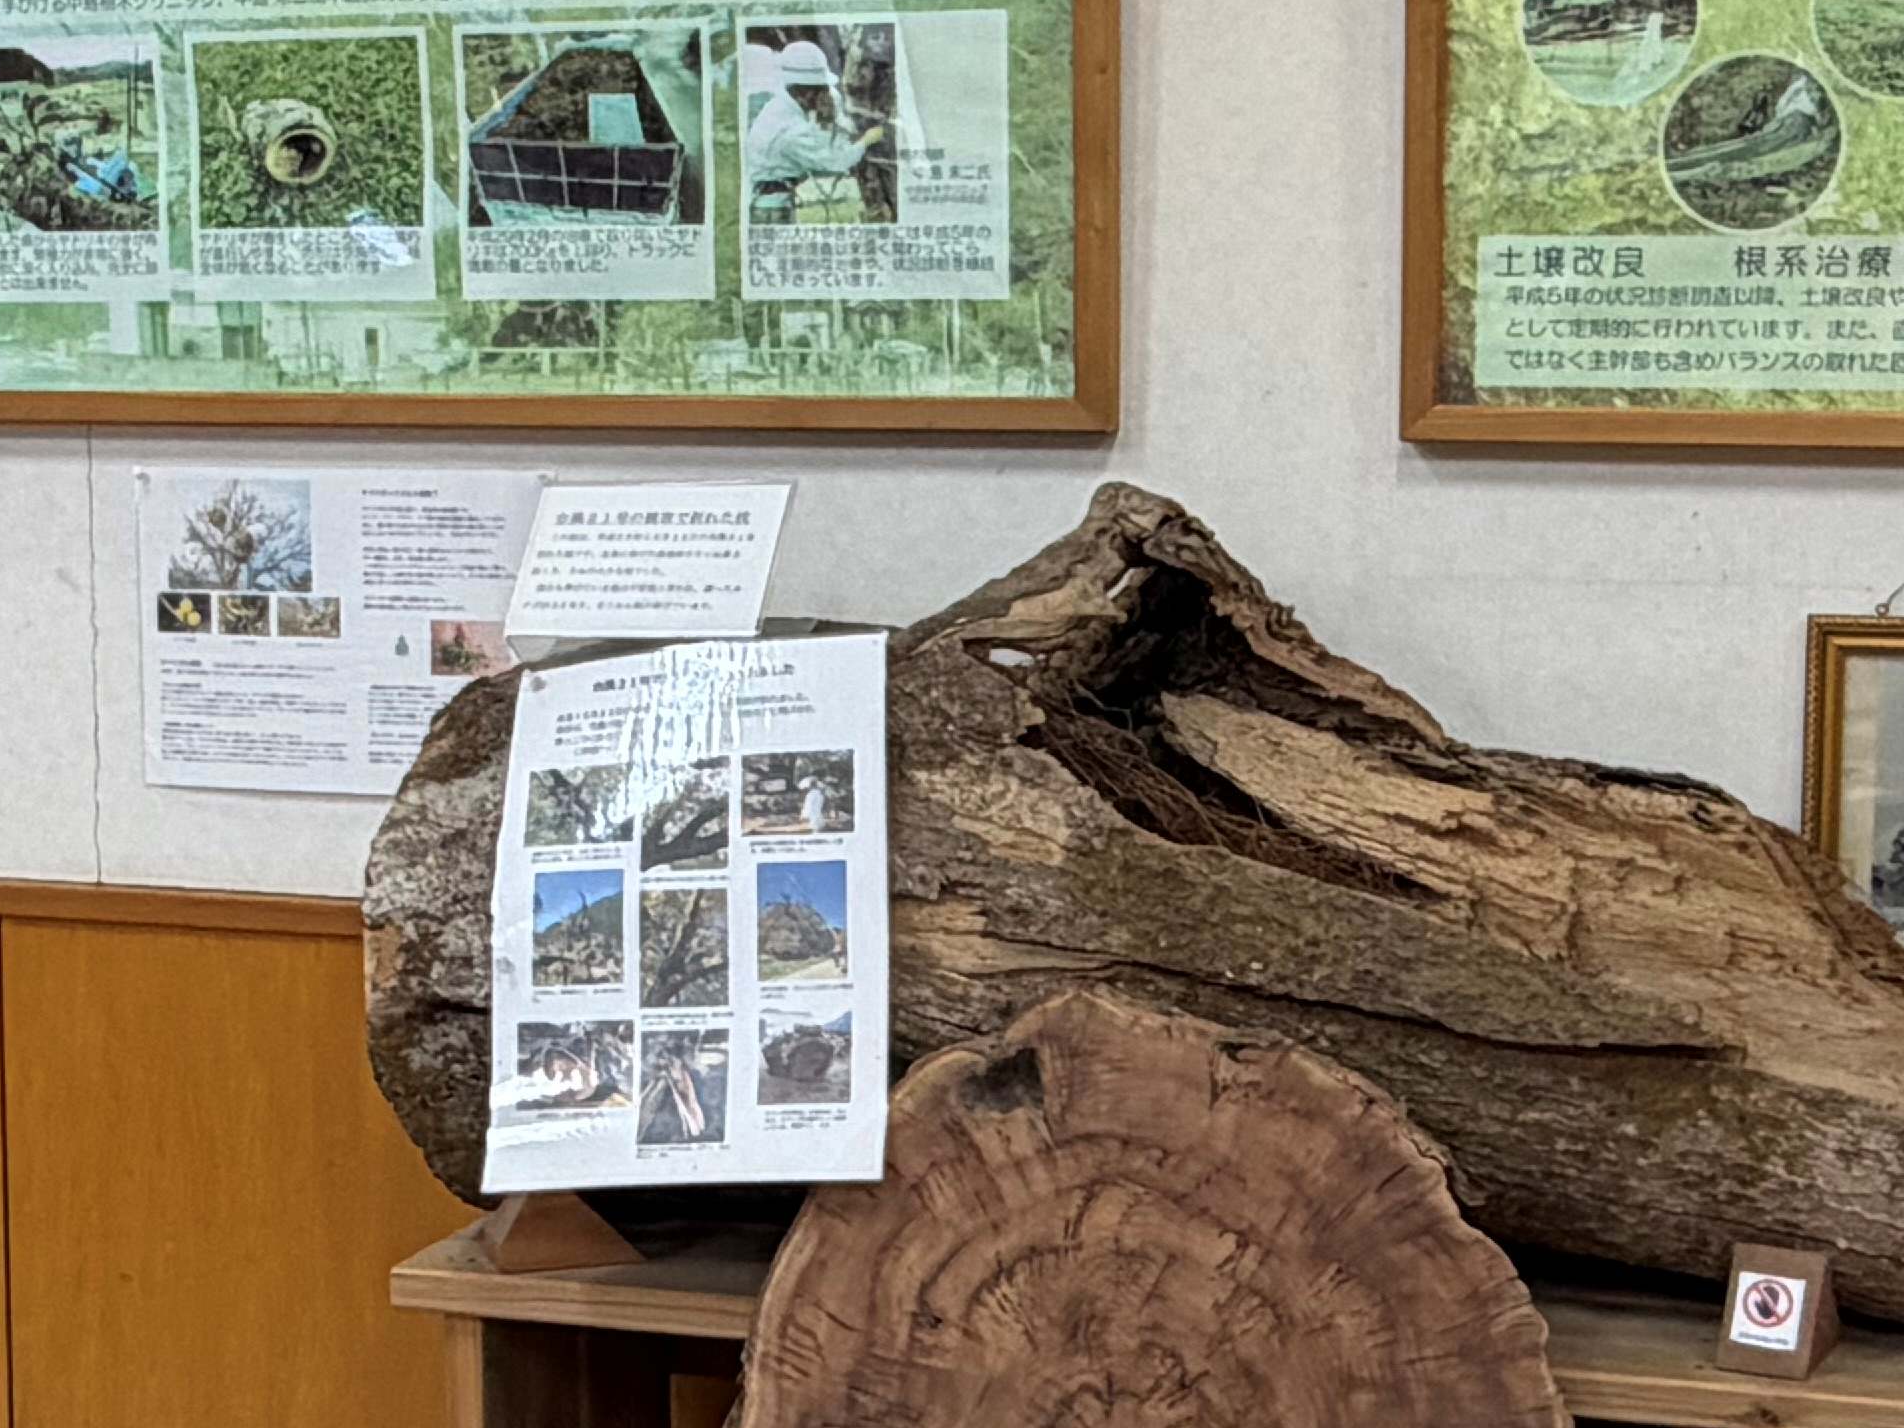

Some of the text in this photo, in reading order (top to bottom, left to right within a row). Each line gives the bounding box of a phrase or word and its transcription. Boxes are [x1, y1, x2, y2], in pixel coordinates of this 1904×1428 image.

[1494, 245, 1646, 278] 土壌改良
[1735, 244, 1892, 278] 根系治療
